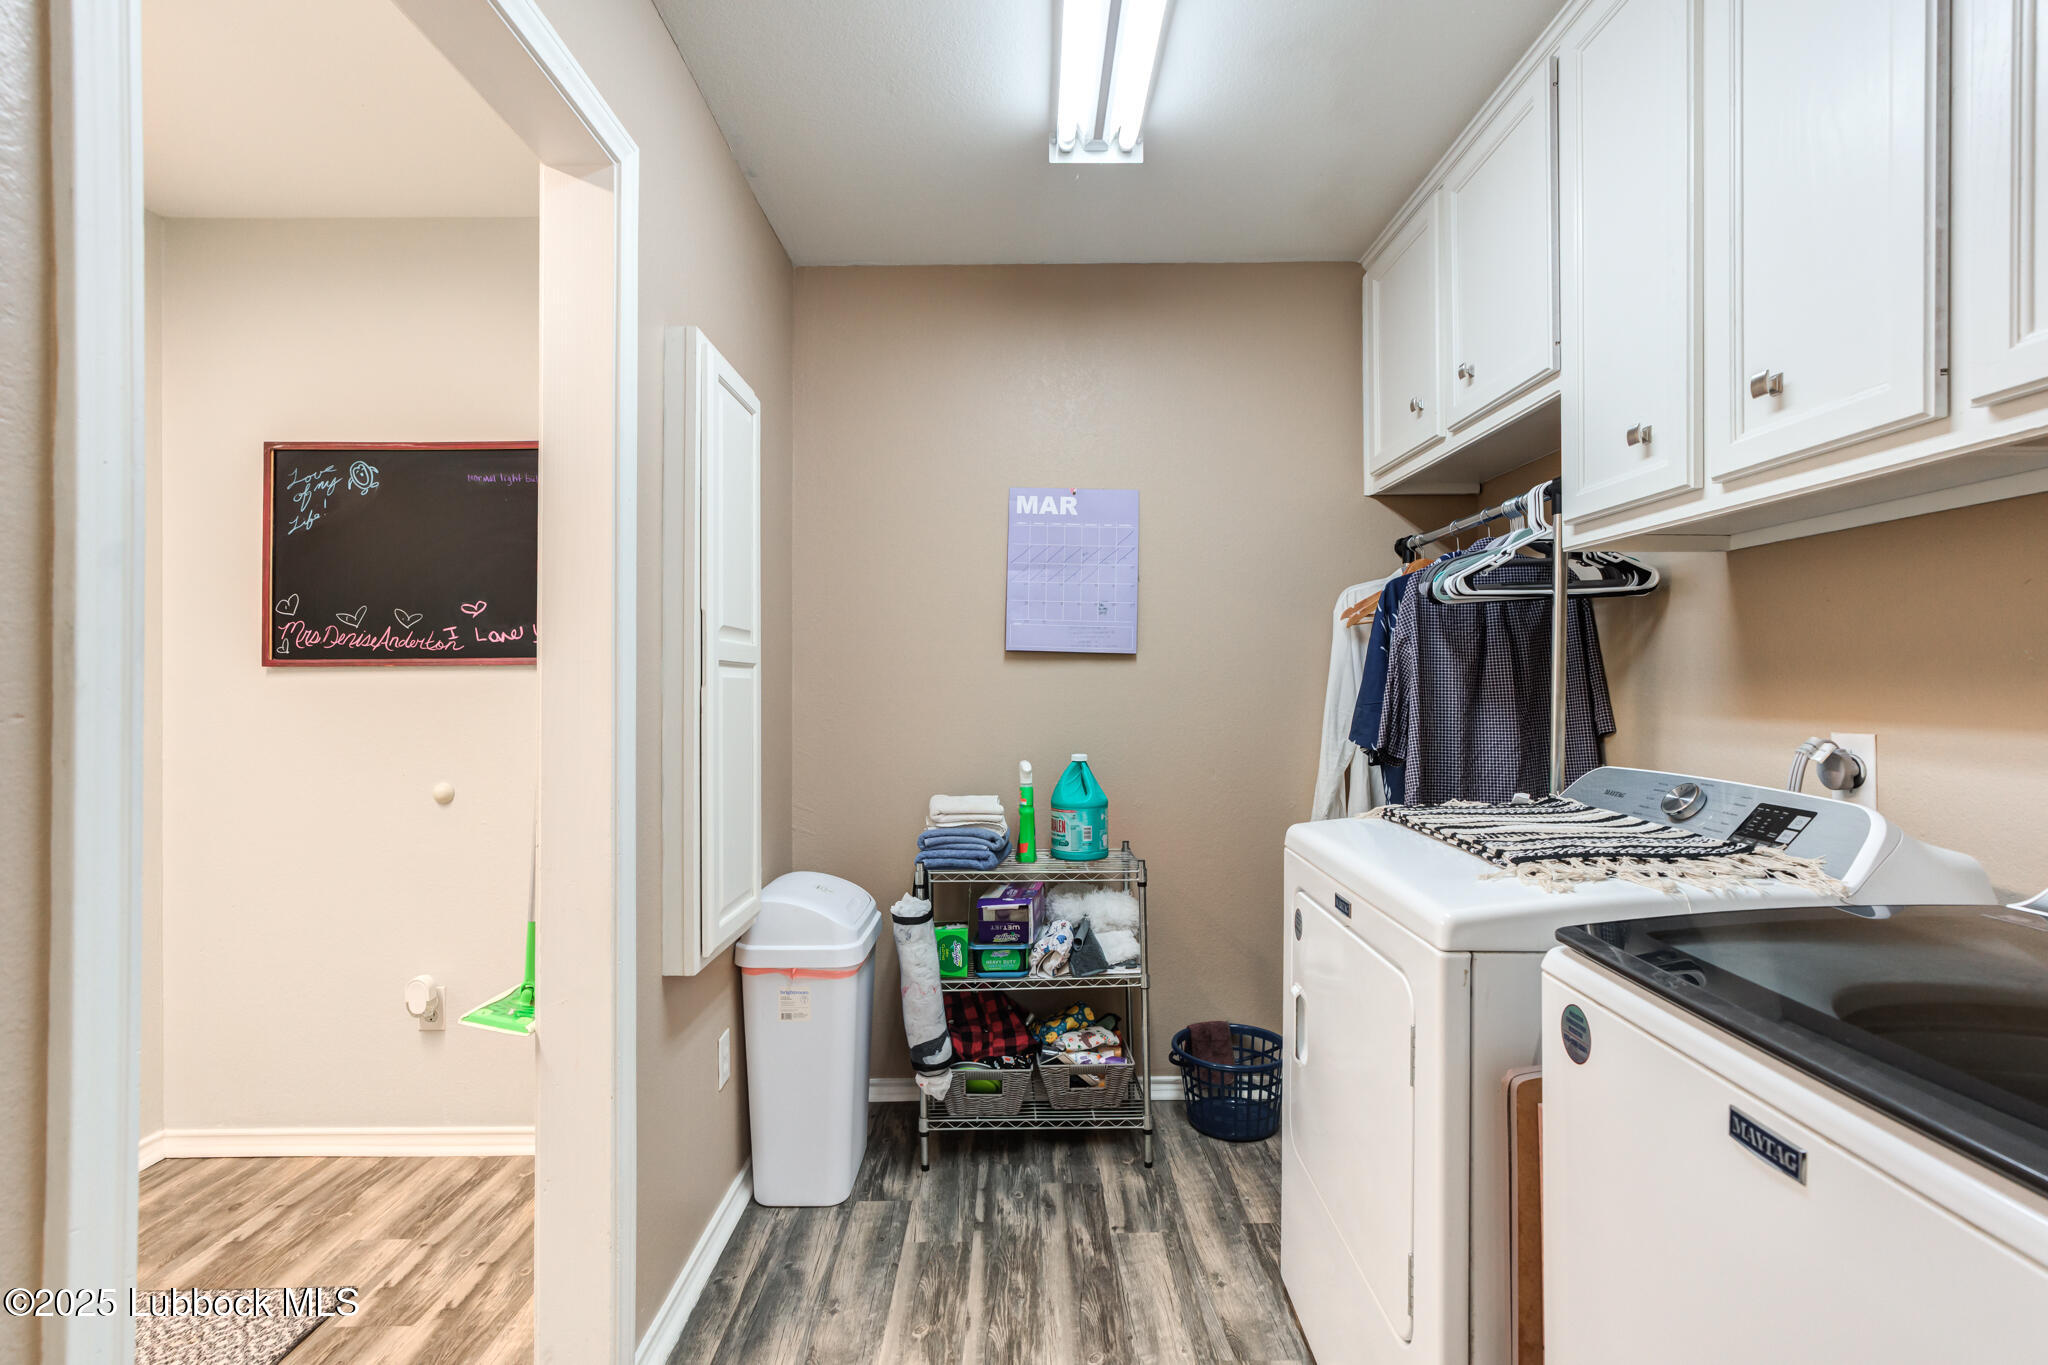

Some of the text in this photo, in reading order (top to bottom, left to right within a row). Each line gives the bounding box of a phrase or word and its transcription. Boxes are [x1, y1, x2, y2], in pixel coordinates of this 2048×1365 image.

[287, 464, 337, 490] Love
[500, 472, 521, 486] light
[293, 477, 343, 512] of my
[1016, 495, 1078, 515] MAR
[1732, 1114, 1797, 1173] MAYTAG
